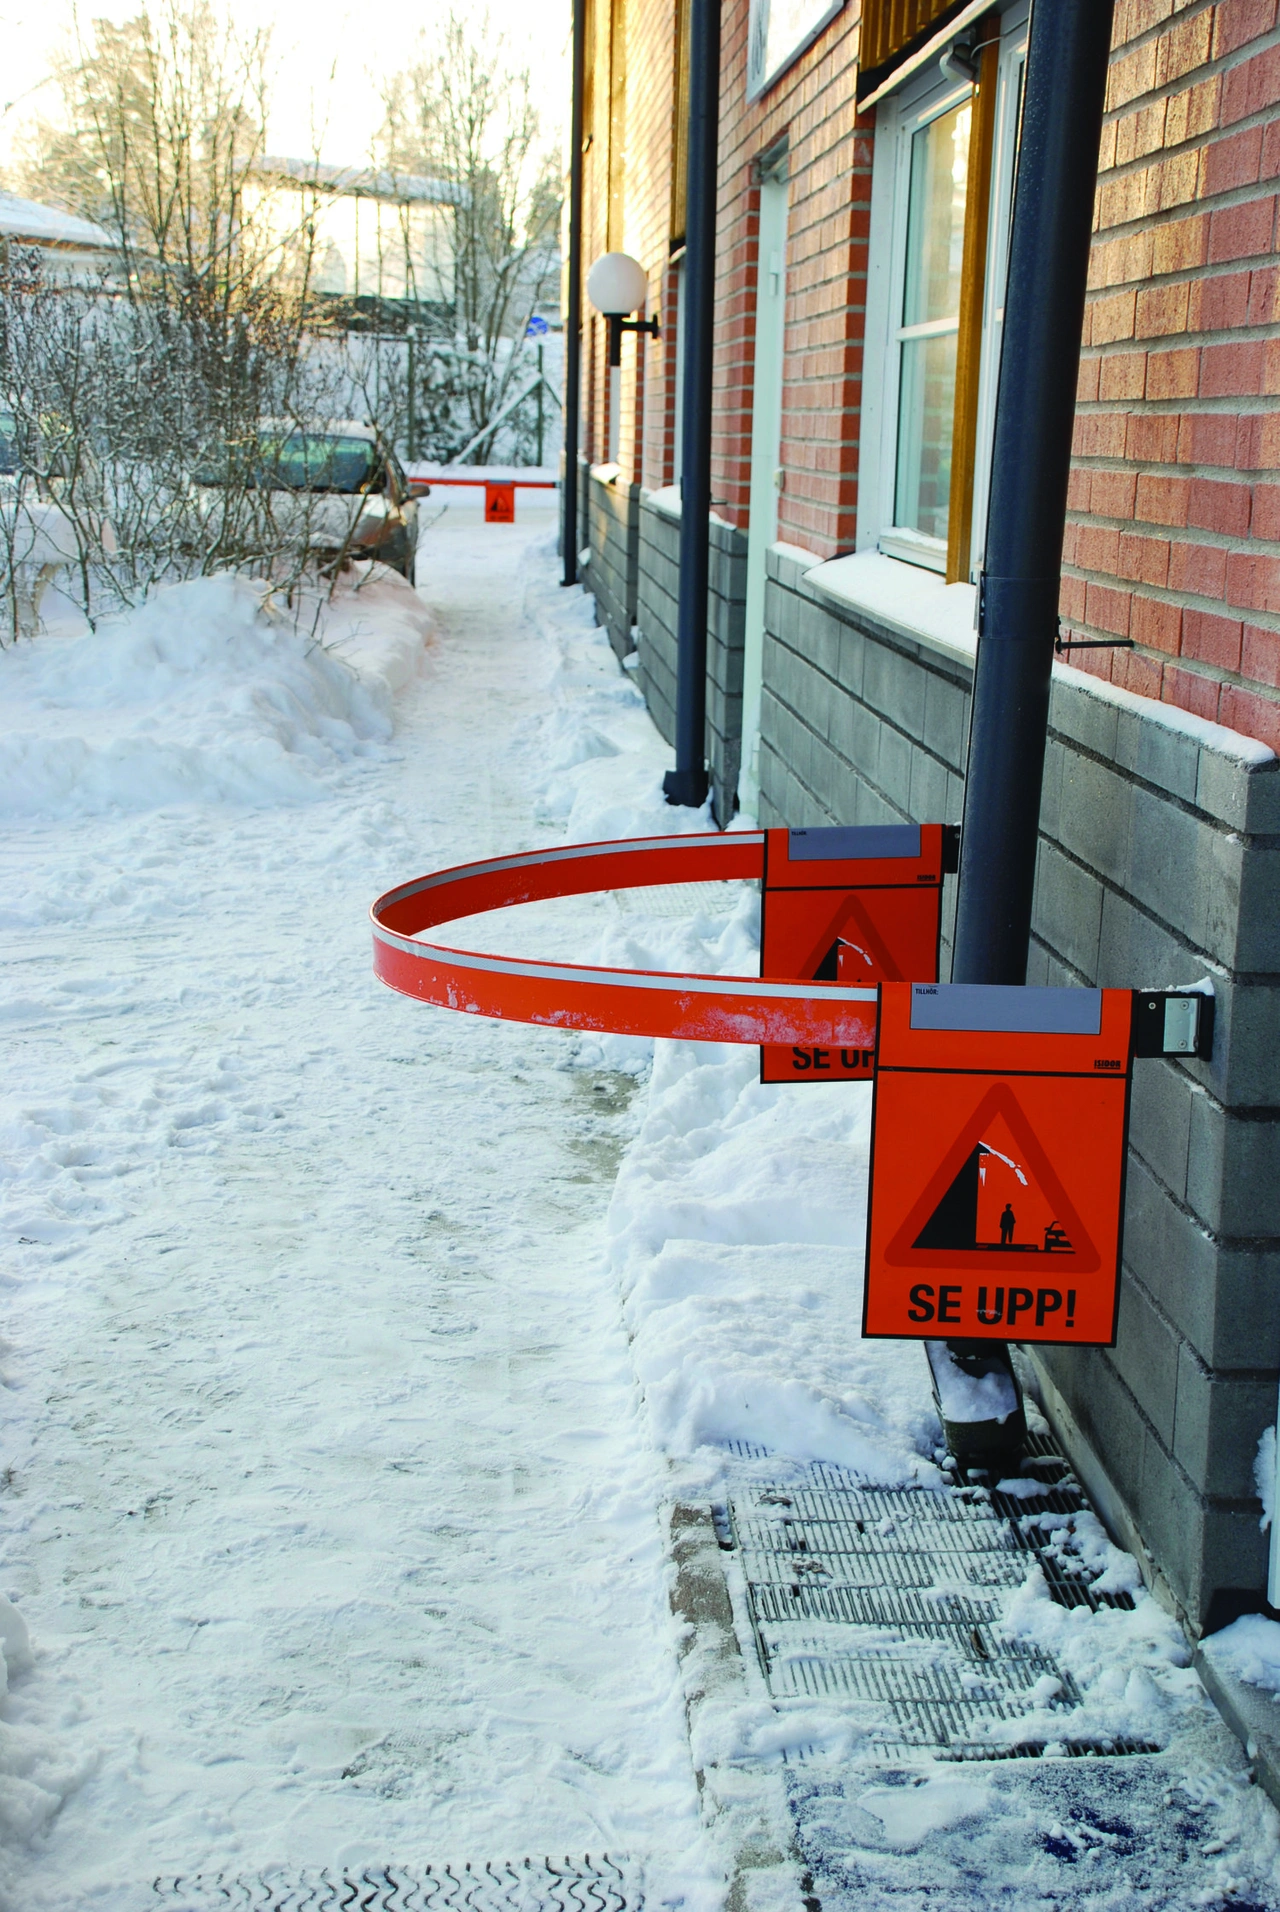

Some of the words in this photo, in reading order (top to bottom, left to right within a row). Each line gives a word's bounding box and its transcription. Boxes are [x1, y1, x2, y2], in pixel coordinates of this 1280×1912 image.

[792, 1047, 831, 1070] SE
[908, 1284, 962, 1323] SE
[976, 1286, 1076, 1328] UPP!
